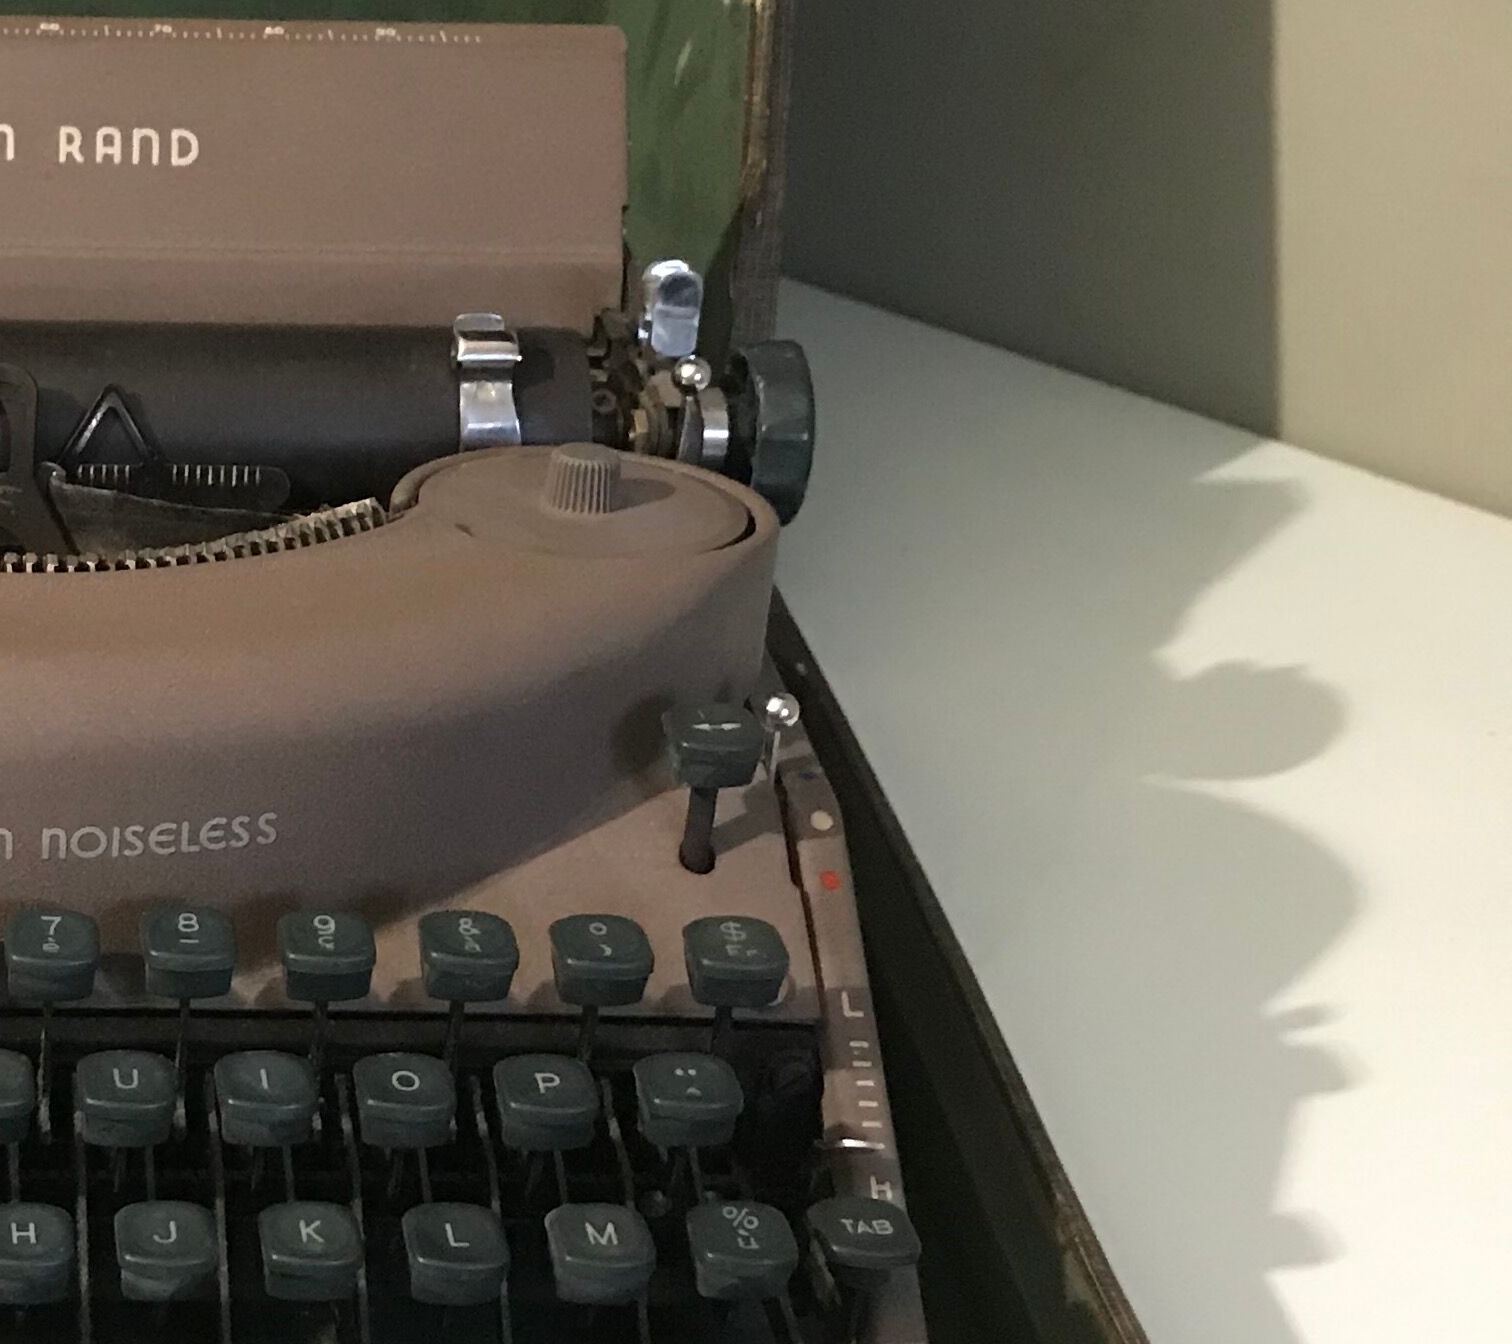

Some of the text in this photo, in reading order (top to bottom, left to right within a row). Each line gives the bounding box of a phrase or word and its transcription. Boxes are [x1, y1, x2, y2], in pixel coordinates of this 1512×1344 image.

[58, 125, 200, 167] RAND
[41, 811, 278, 860] NOISELESS
[40, 915, 63, 937] 7
[177, 912, 200, 933] 8
[313, 914, 336, 936] 9
[719, 920, 748, 942] $
[841, 991, 865, 1018] L
[113, 1068, 139, 1089] U
[258, 1069, 269, 1090] I
[391, 1070, 421, 1091] O
[534, 1071, 561, 1093] P
[722, 1206, 760, 1230] %
[840, 1218, 894, 1236] TAB
[11, 1222, 37, 1245] H
[153, 1221, 177, 1244] J
[299, 1219, 325, 1244] K
[445, 1223, 470, 1248] L
[586, 1222, 619, 1245] M
